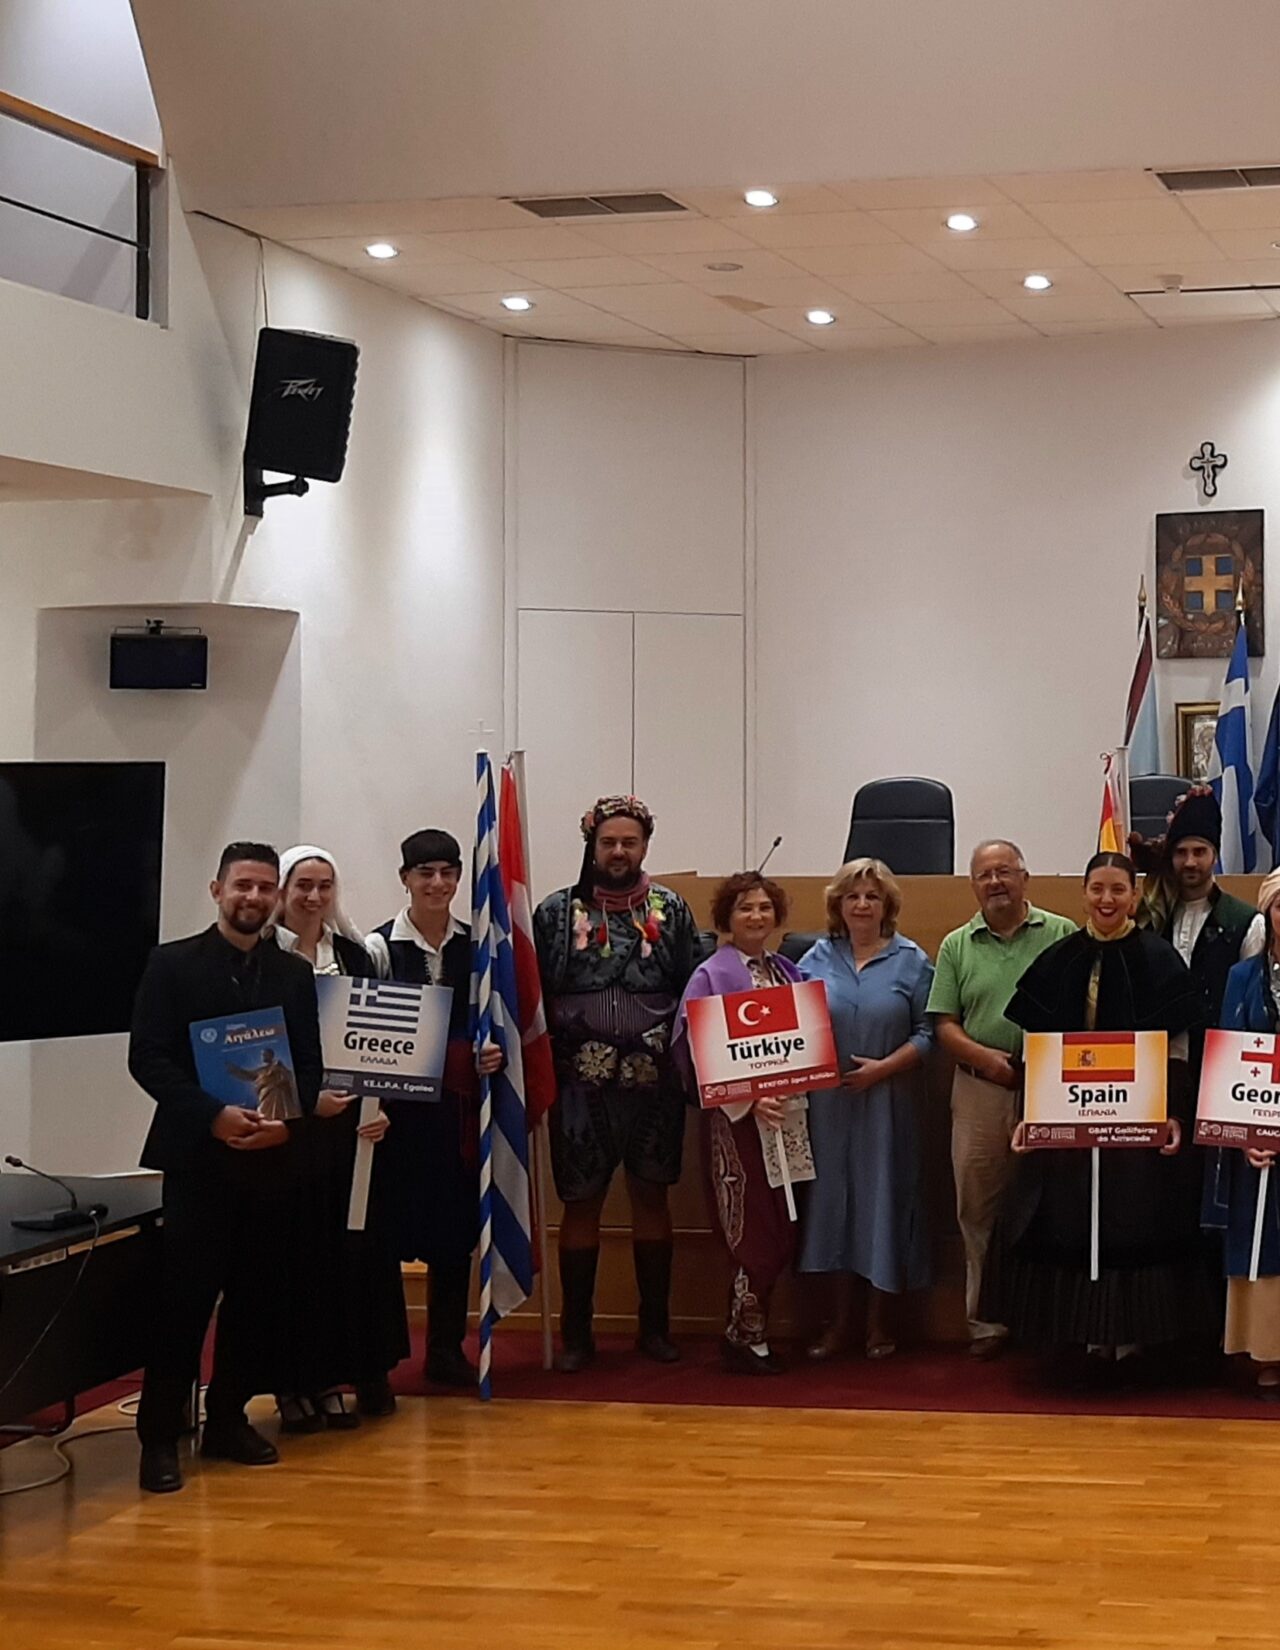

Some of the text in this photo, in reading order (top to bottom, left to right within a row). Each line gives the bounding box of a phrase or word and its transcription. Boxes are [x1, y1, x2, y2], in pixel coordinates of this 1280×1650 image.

[344, 1030, 415, 1055] Greece
[727, 1036, 805, 1061] Türkiye
[360, 1055, 398, 1066] ΕΛΛΑΔΑ
[750, 1058, 790, 1070] ΤΟΥΡΚΙΑ
[1068, 1084, 1128, 1108] Spain
[1078, 1108, 1118, 1117] ΙΣΠΑΝΙΑ
